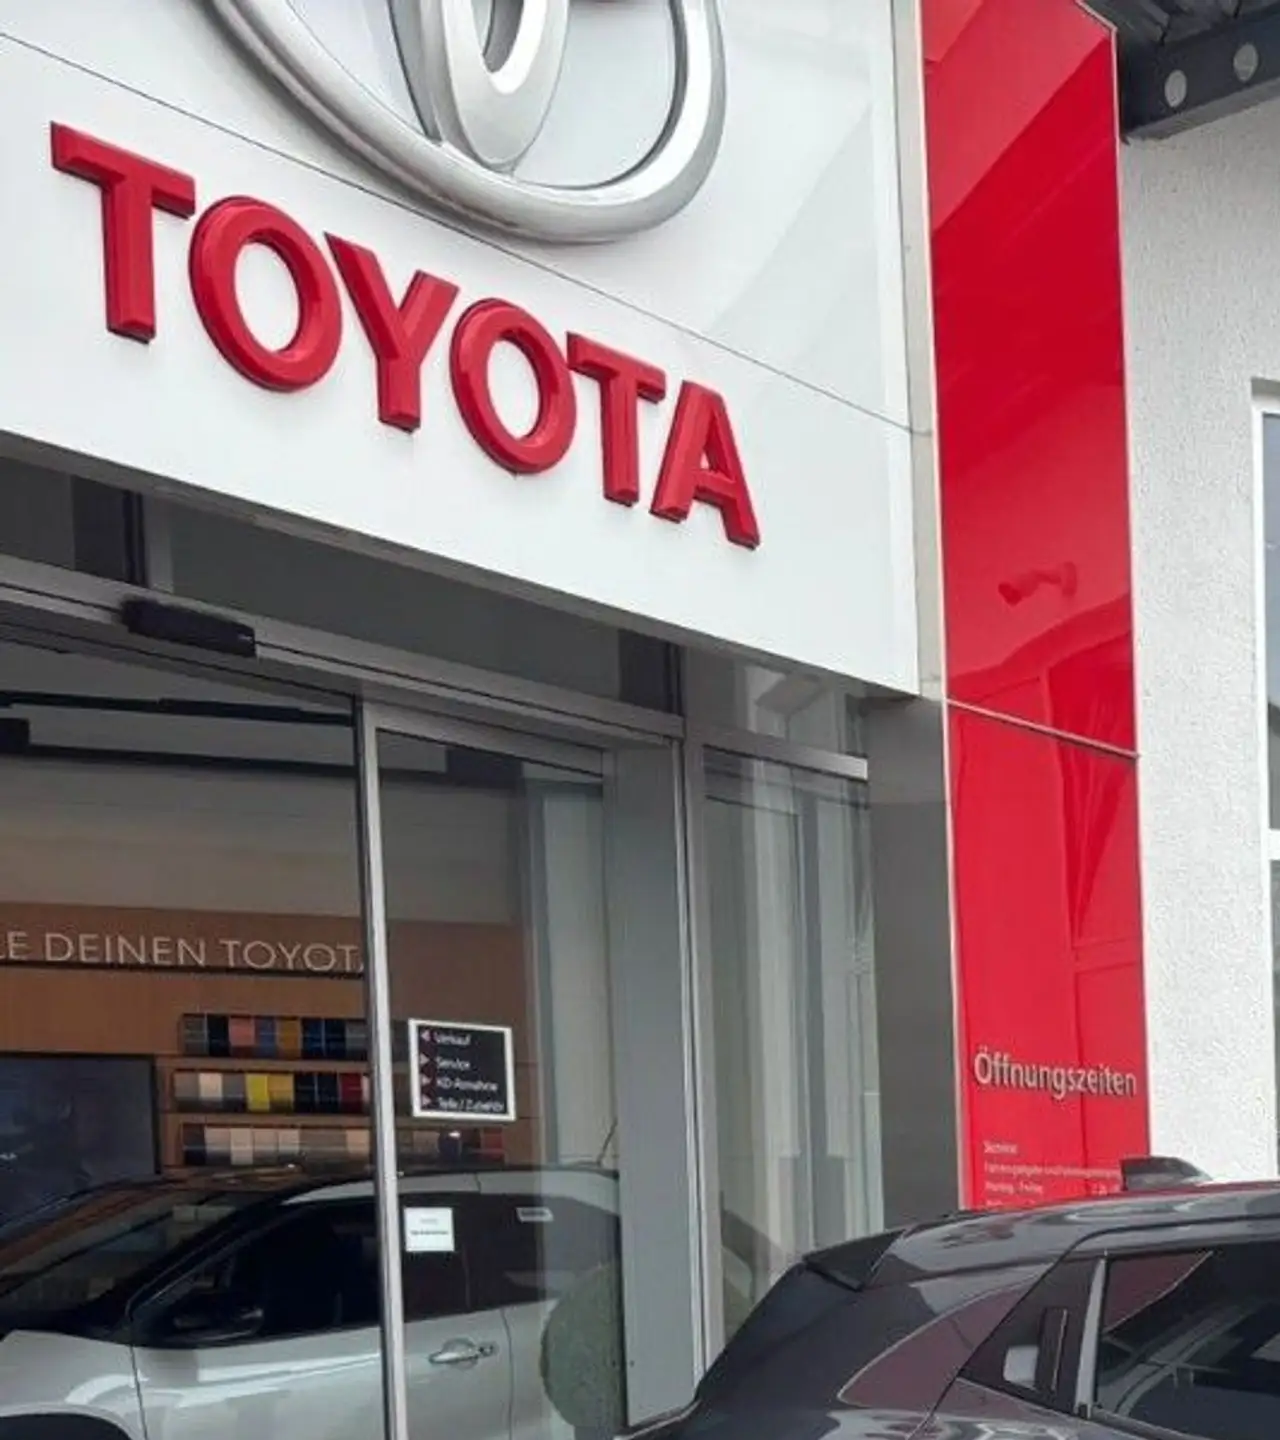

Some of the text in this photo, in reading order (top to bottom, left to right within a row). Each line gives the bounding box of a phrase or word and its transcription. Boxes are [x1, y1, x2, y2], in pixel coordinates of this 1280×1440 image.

[50, 121, 762, 550] TOYOTA
[45, 932, 206, 967] DEINEN
[219, 938, 365, 973] TOYOT
[974, 1044, 1138, 1101] Öffnungszeiten
